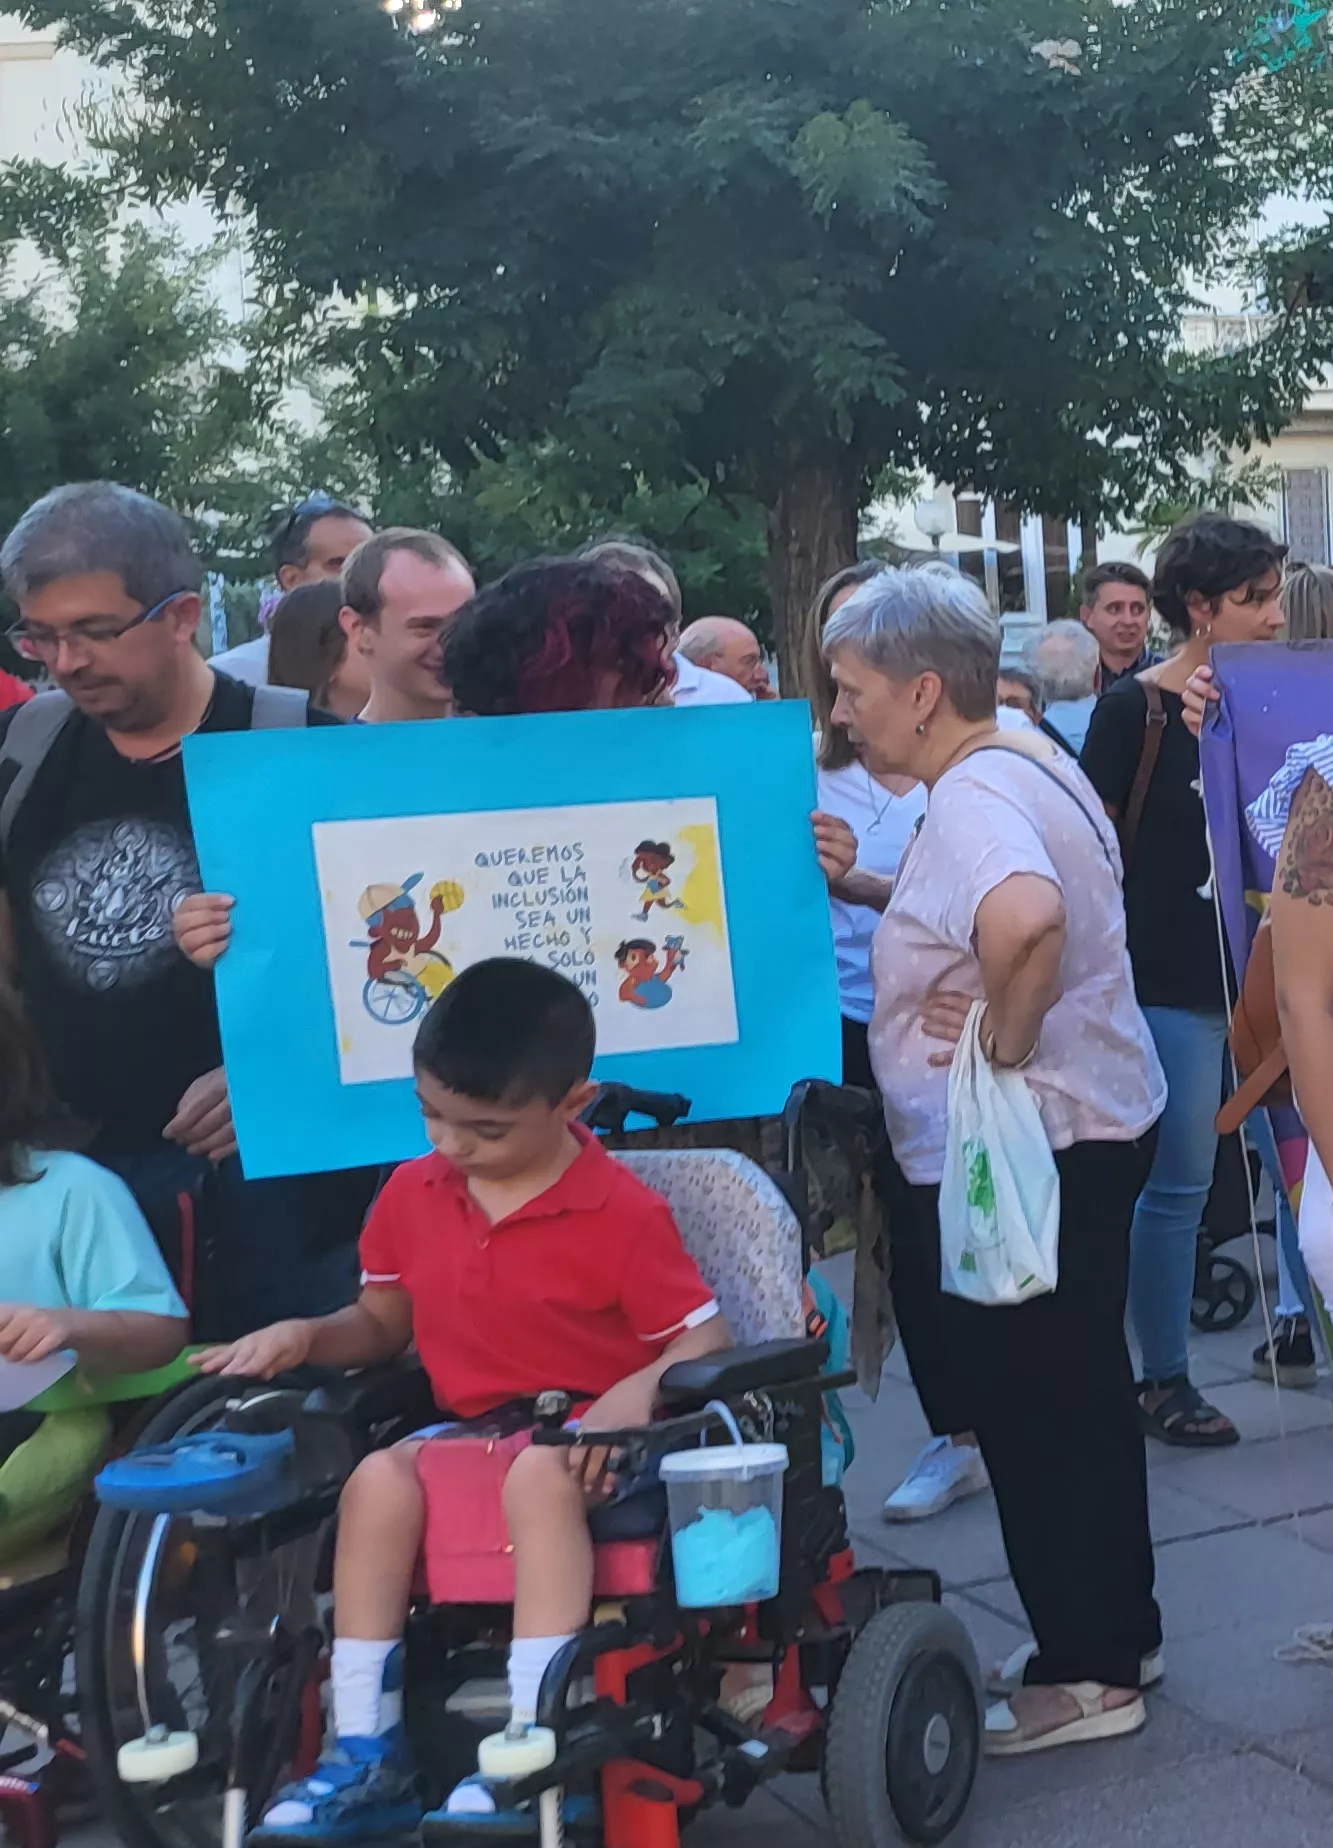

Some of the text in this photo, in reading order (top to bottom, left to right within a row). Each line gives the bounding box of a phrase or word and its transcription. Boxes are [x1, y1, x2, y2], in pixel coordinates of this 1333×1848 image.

[474, 841, 585, 868] QUEREMOS
[507, 864, 587, 887] QUE LA
[514, 905, 591, 930] SEA UN
[503, 926, 593, 950] HECHO Y
